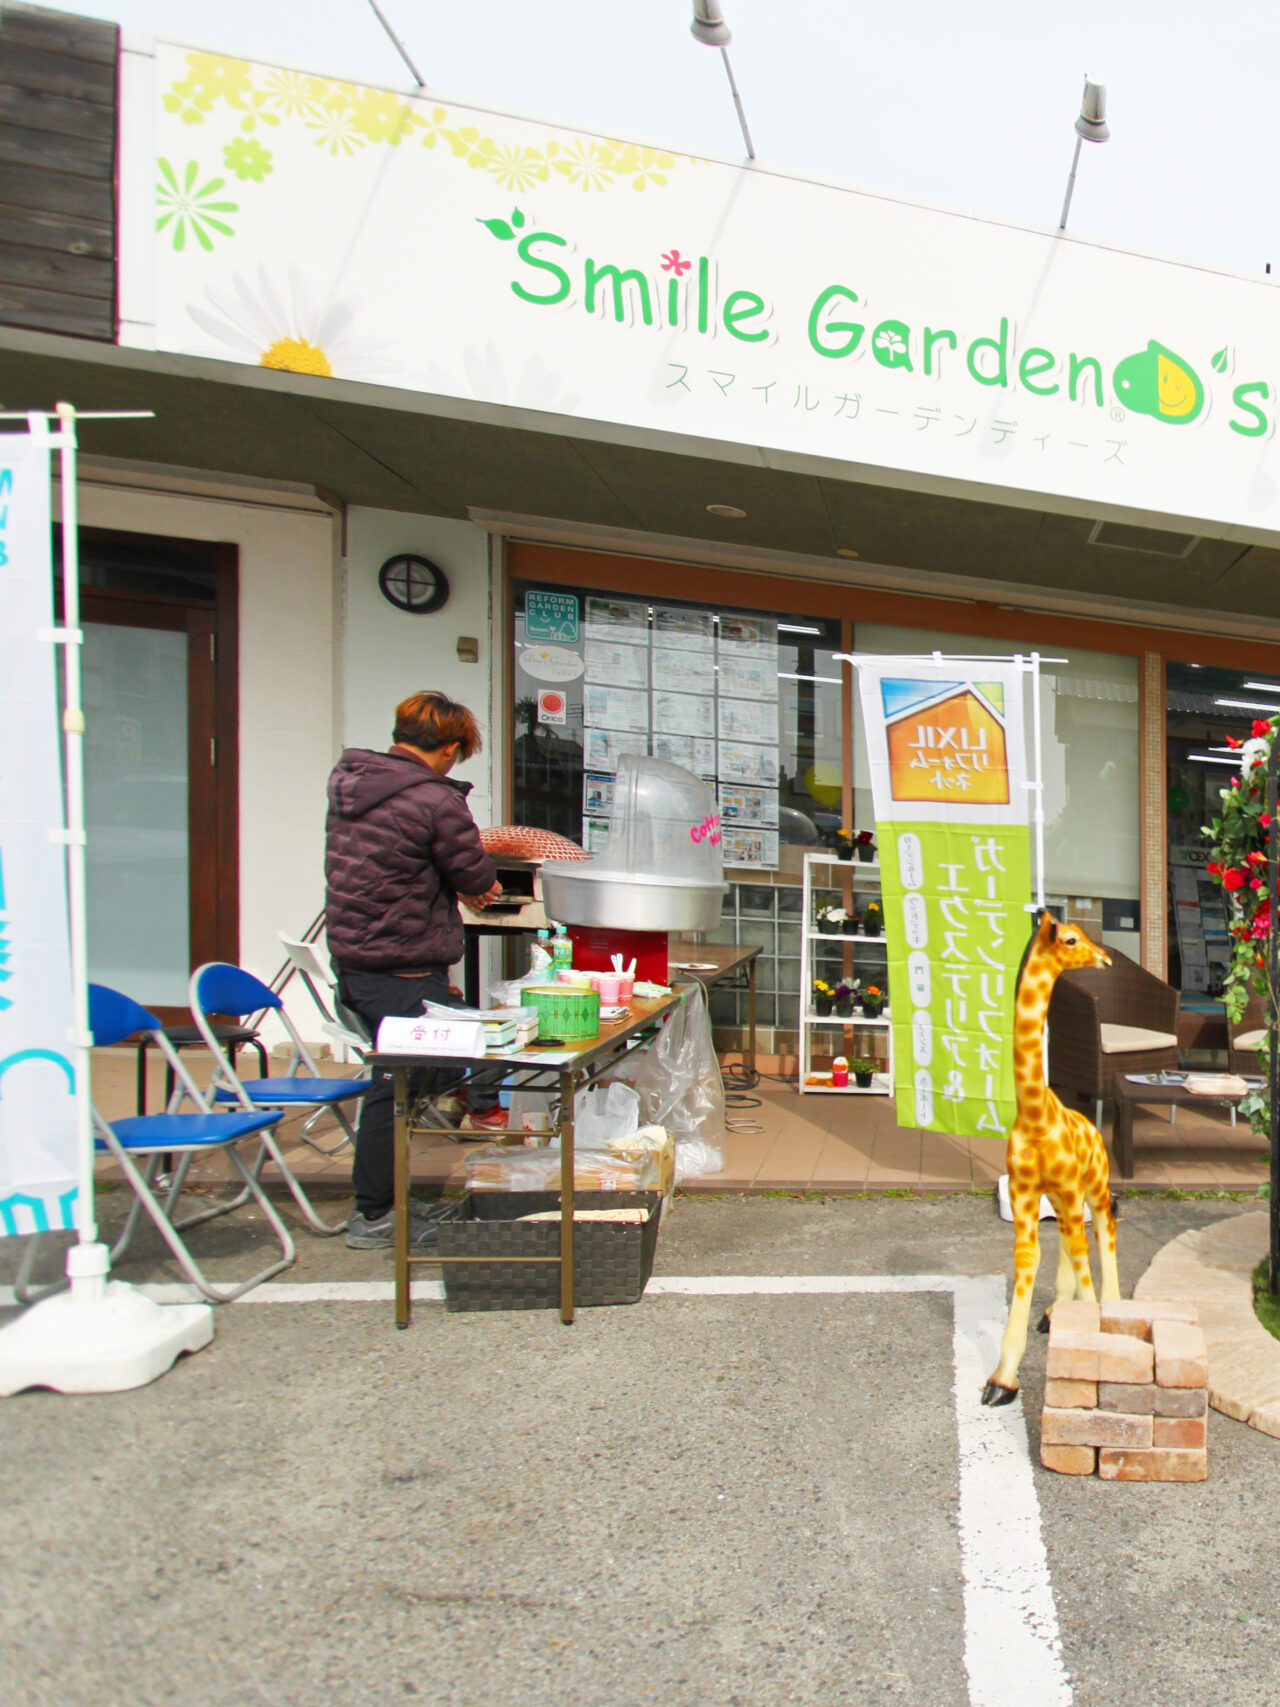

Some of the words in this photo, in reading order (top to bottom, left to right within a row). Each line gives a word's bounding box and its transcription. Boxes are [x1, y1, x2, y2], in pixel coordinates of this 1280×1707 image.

[511, 232, 770, 342] Smile
[666, 362, 1128, 466] スマイルガーデンディーズ
[528, 593, 575, 605] REFORM
[528, 601, 575, 613] GARDEN
[410, 1025, 452, 1041] 受付
